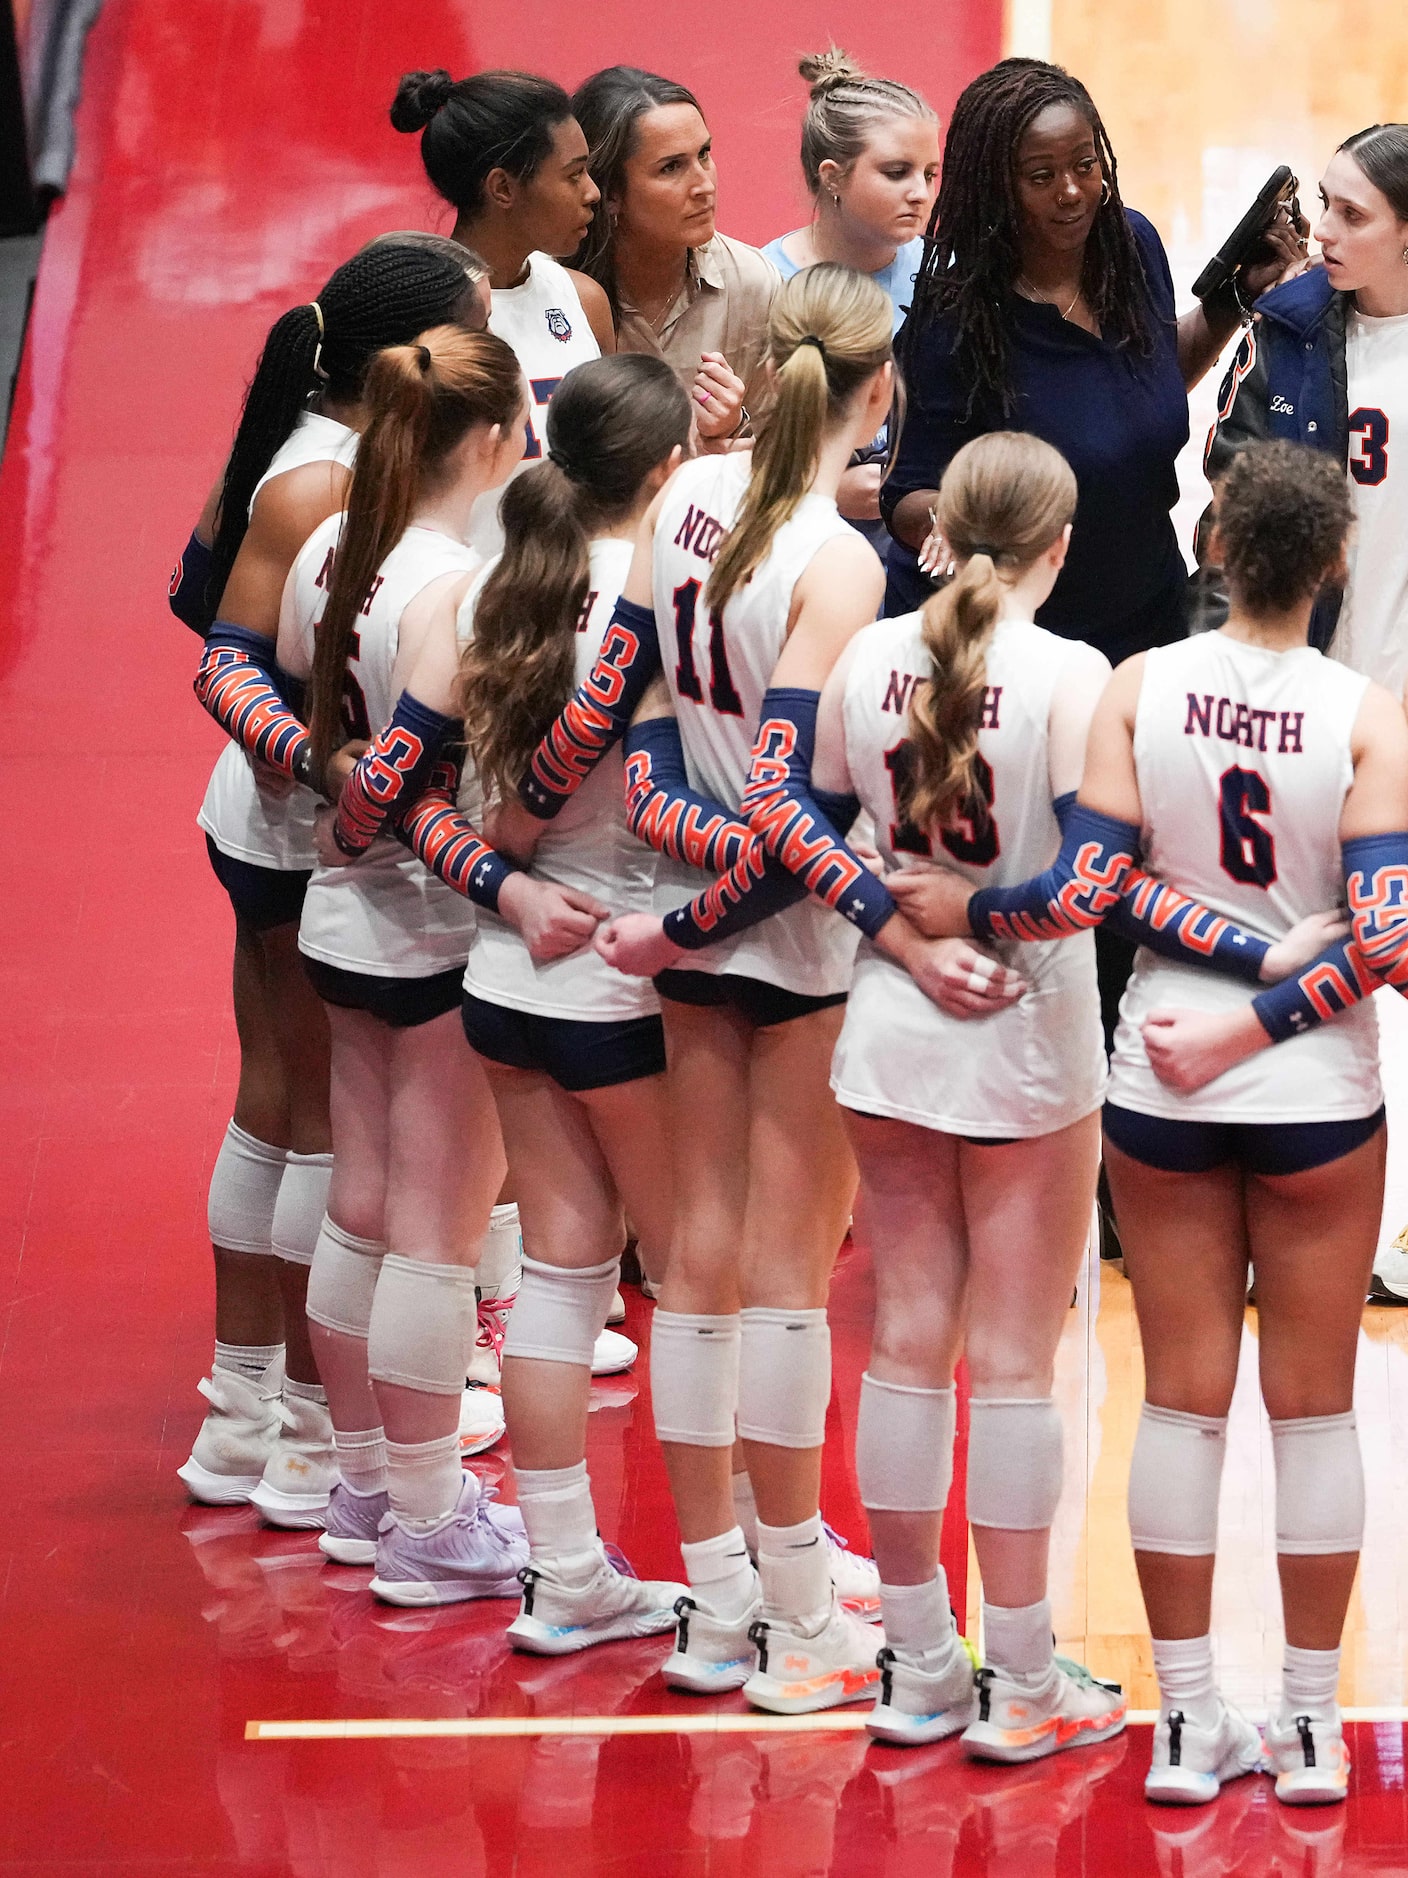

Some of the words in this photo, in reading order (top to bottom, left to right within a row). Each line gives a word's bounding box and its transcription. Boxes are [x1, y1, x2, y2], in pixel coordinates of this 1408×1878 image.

[1269, 394, 1295, 416] Zoe
[1347, 406, 1390, 487] 3
[673, 576, 745, 720] 11
[1184, 692, 1306, 754] NORTH
[883, 738, 1001, 868] 13
[1217, 764, 1279, 891] 6
